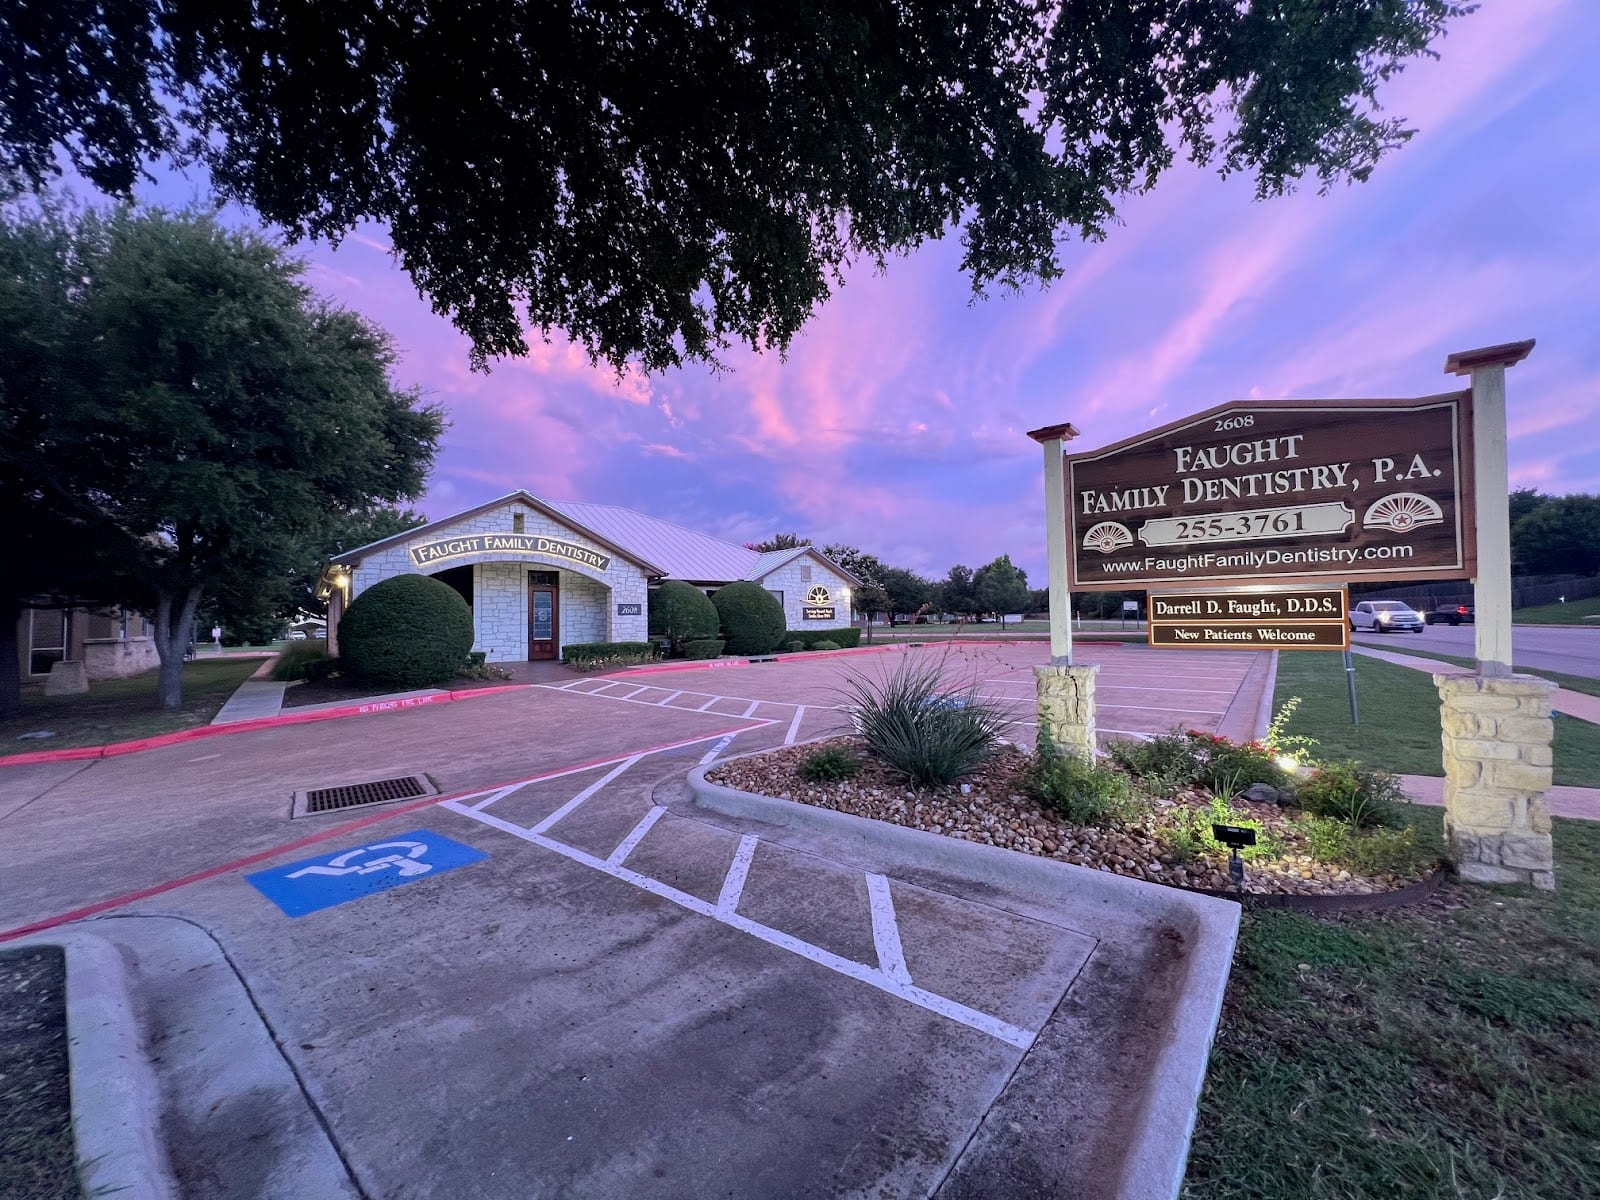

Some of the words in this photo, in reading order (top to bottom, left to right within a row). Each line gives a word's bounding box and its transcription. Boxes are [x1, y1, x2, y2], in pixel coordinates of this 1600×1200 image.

[1214, 415, 1255, 432] 2608
[1173, 434, 1304, 473] FAUGHT
[1081, 485, 1170, 515] FAMILY
[1181, 463, 1360, 504] DENTISTRY,
[1372, 453, 1442, 484] P.A.
[1175, 511, 1305, 540] 255-3761
[418, 539, 480, 561] FAUGHT
[484, 536, 535, 550] FAMILY
[538, 538, 606, 567] DENTISTRY
[1102, 544, 1413, 573] www.FaughtFamilyDentistry.com
[1156, 600, 1202, 615] Darrell
[1206, 600, 1223, 614] D.
[1227, 599, 1281, 617] Faught,
[1286, 597, 1338, 613] D.D.S.
[1174, 629, 1200, 640] New
[1204, 628, 1253, 640] Patients
[1257, 628, 1316, 641] Welcome
